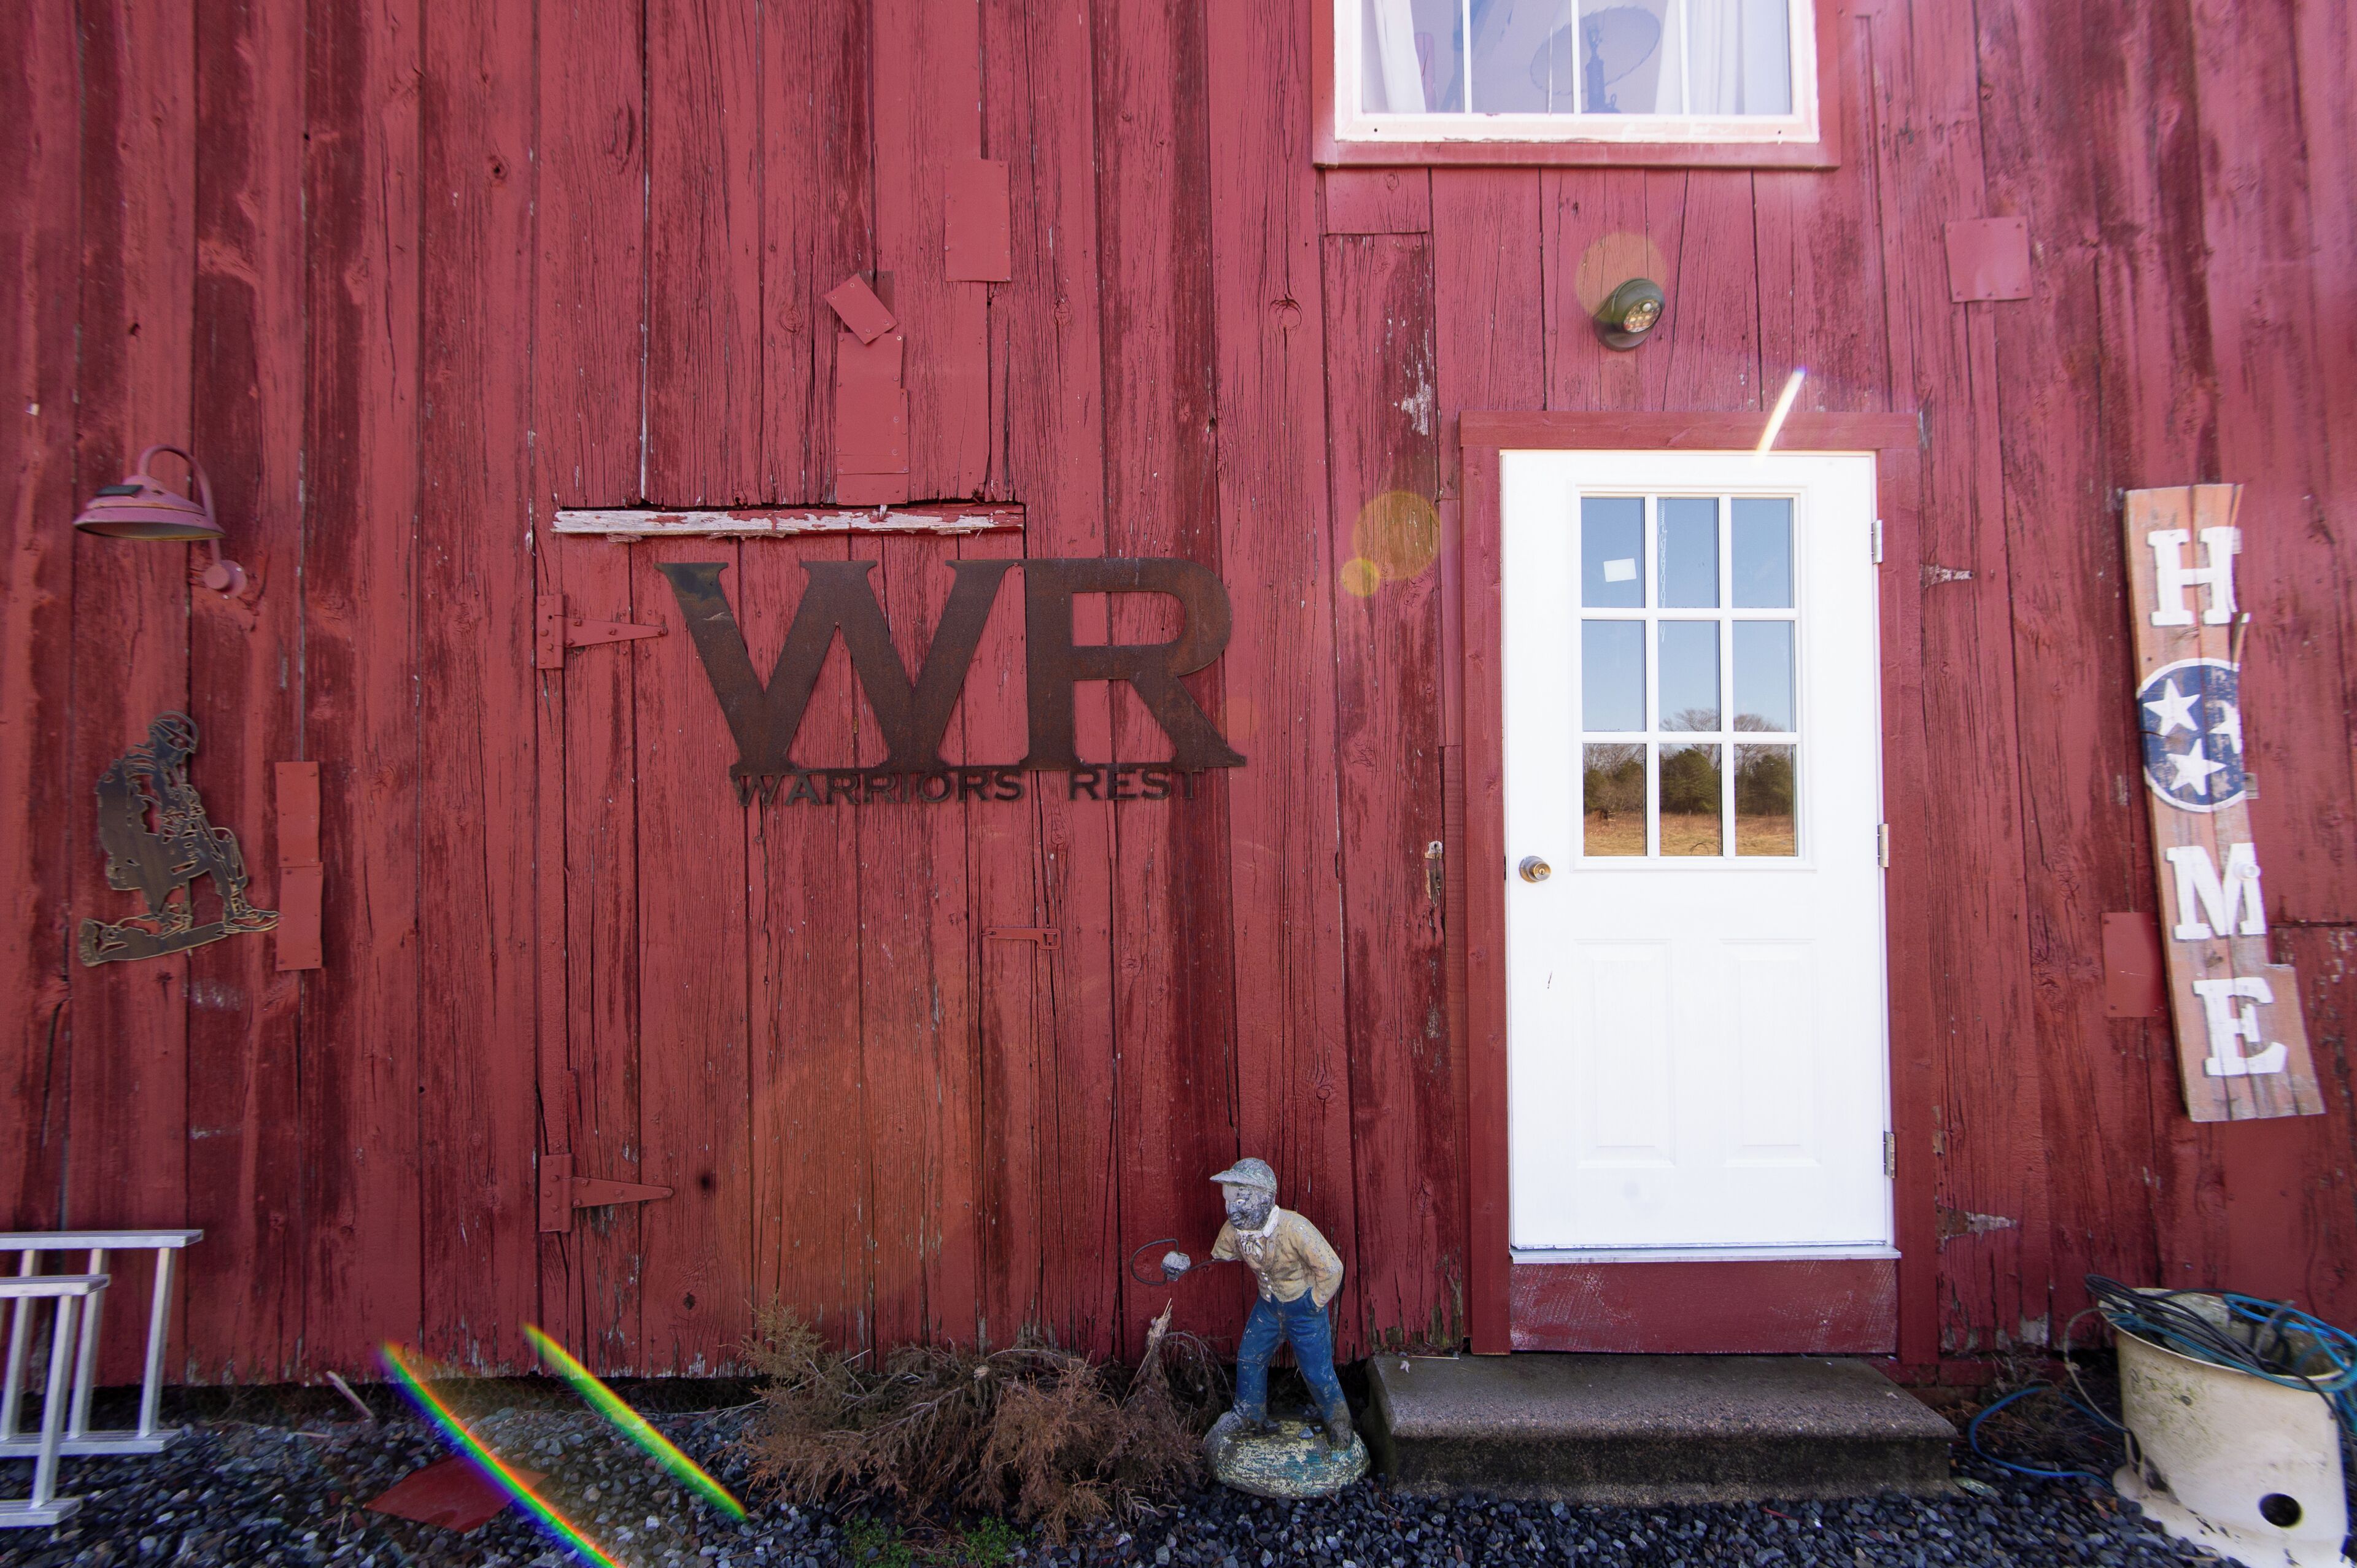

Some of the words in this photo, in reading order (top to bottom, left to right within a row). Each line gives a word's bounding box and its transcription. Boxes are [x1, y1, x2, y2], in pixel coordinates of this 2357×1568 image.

[654, 558, 1246, 770] WR
[730, 768, 1026, 808] WARRIORS
[1069, 767, 1204, 801] REST
